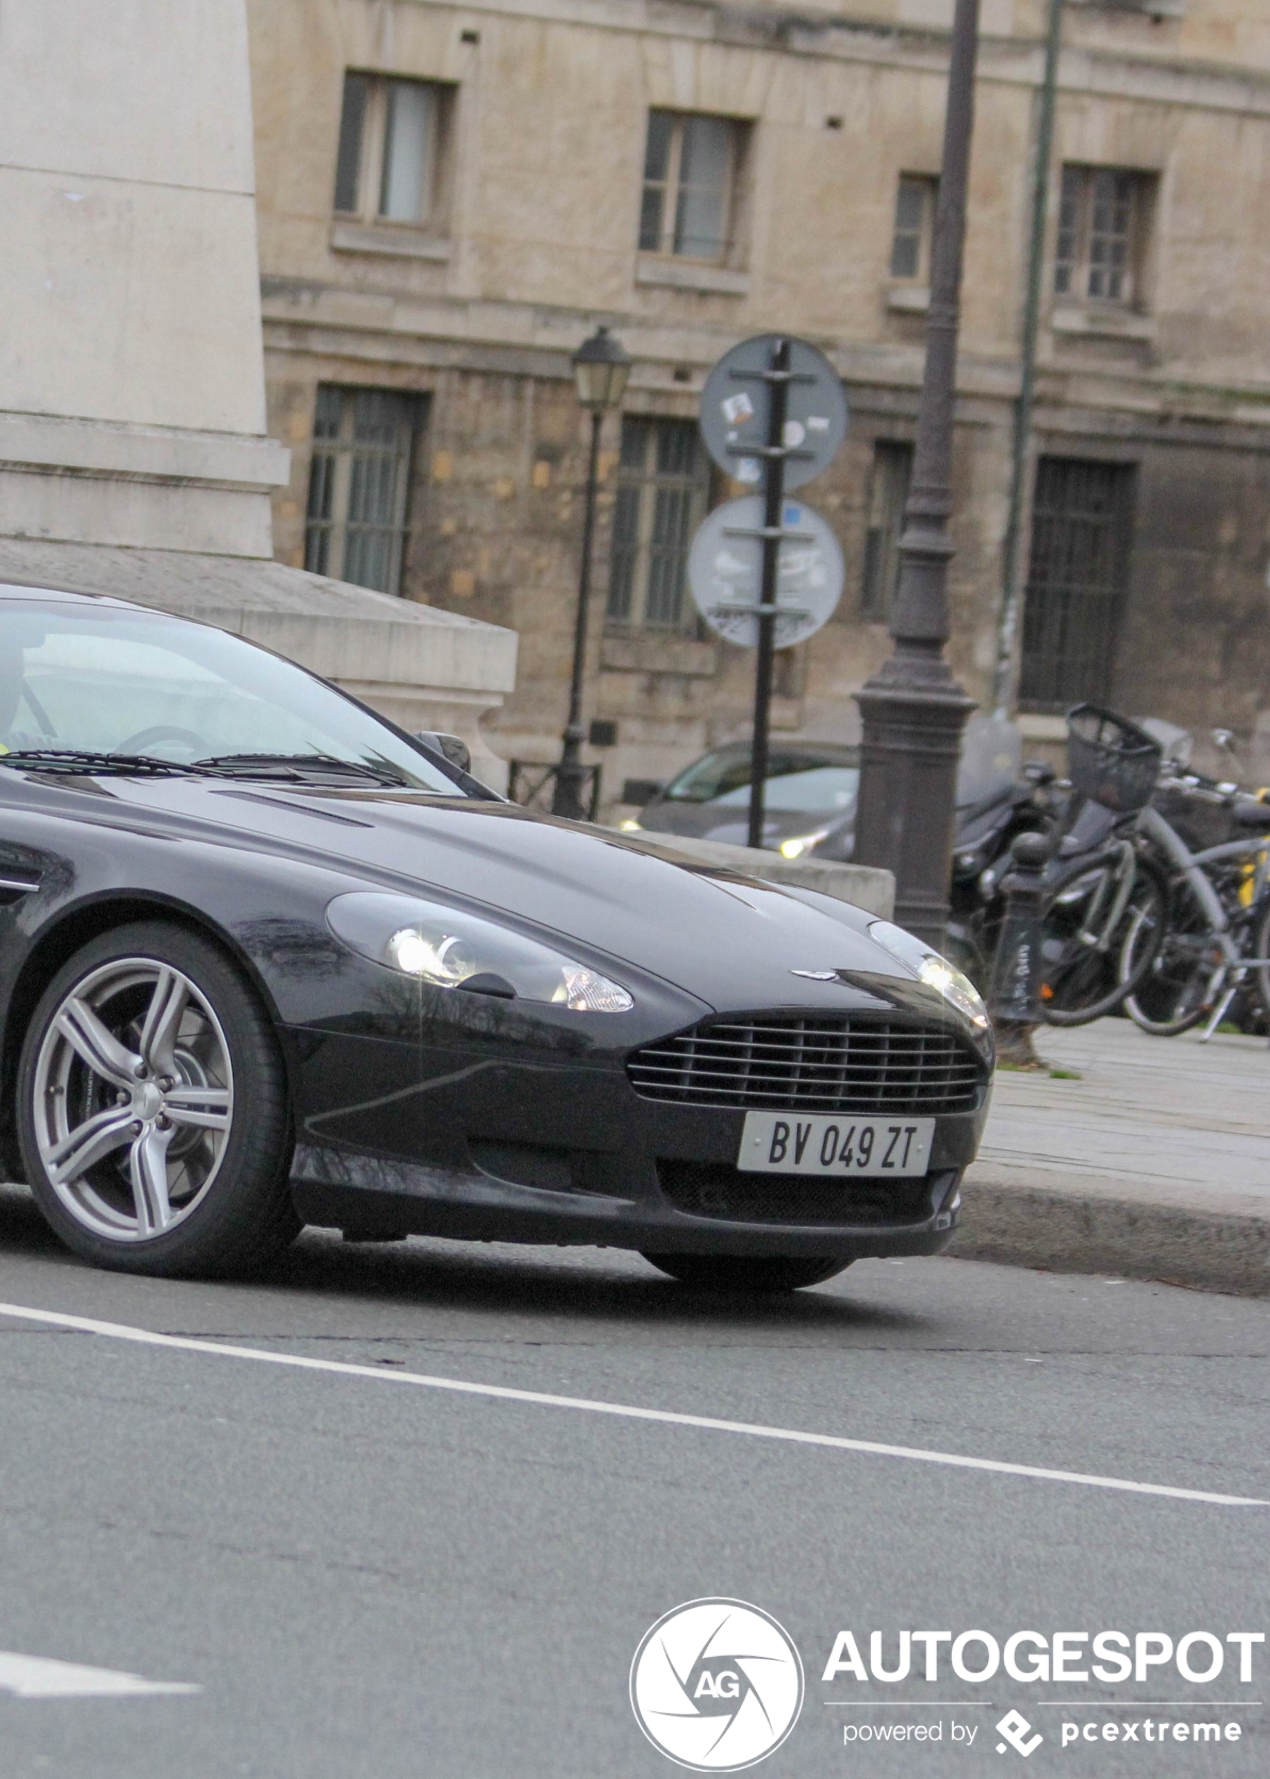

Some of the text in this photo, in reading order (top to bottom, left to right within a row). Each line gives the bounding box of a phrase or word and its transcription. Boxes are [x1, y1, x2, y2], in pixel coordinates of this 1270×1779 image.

[768, 1121, 918, 1169] BV 049 ZT
